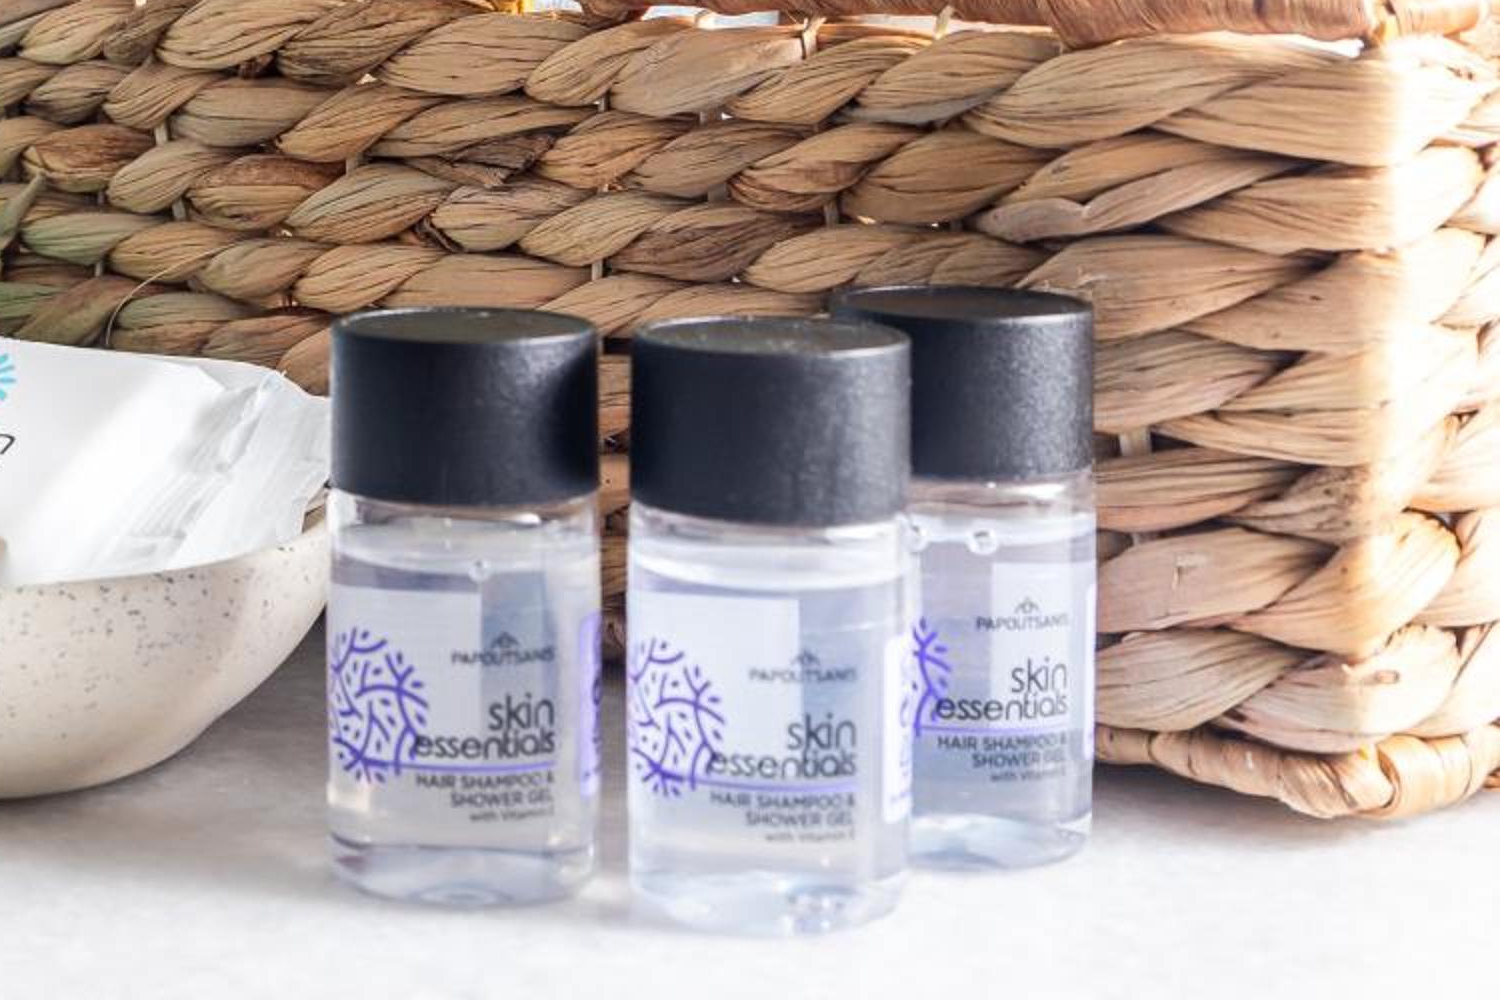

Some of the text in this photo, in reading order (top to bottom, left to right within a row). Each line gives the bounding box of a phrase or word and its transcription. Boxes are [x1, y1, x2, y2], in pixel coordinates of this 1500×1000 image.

[1011, 656, 1068, 694] skin
[488, 692, 556, 732] skin
[934, 693, 1068, 721] essentials
[787, 713, 857, 751] skin
[937, 735, 977, 751] HAIR
[982, 732, 1057, 751] SHAMPOO
[414, 729, 556, 760] essentials
[711, 749, 858, 780] essentials
[971, 751, 1040, 769] SHOWER
[416, 774, 456, 789] HAIR
[460, 771, 543, 790] SHAMPOO
[451, 790, 523, 808] SHOWER
[710, 791, 751, 808] HAIR
[757, 791, 843, 810] SHAMPOO
[745, 810, 822, 827] SHOWER
